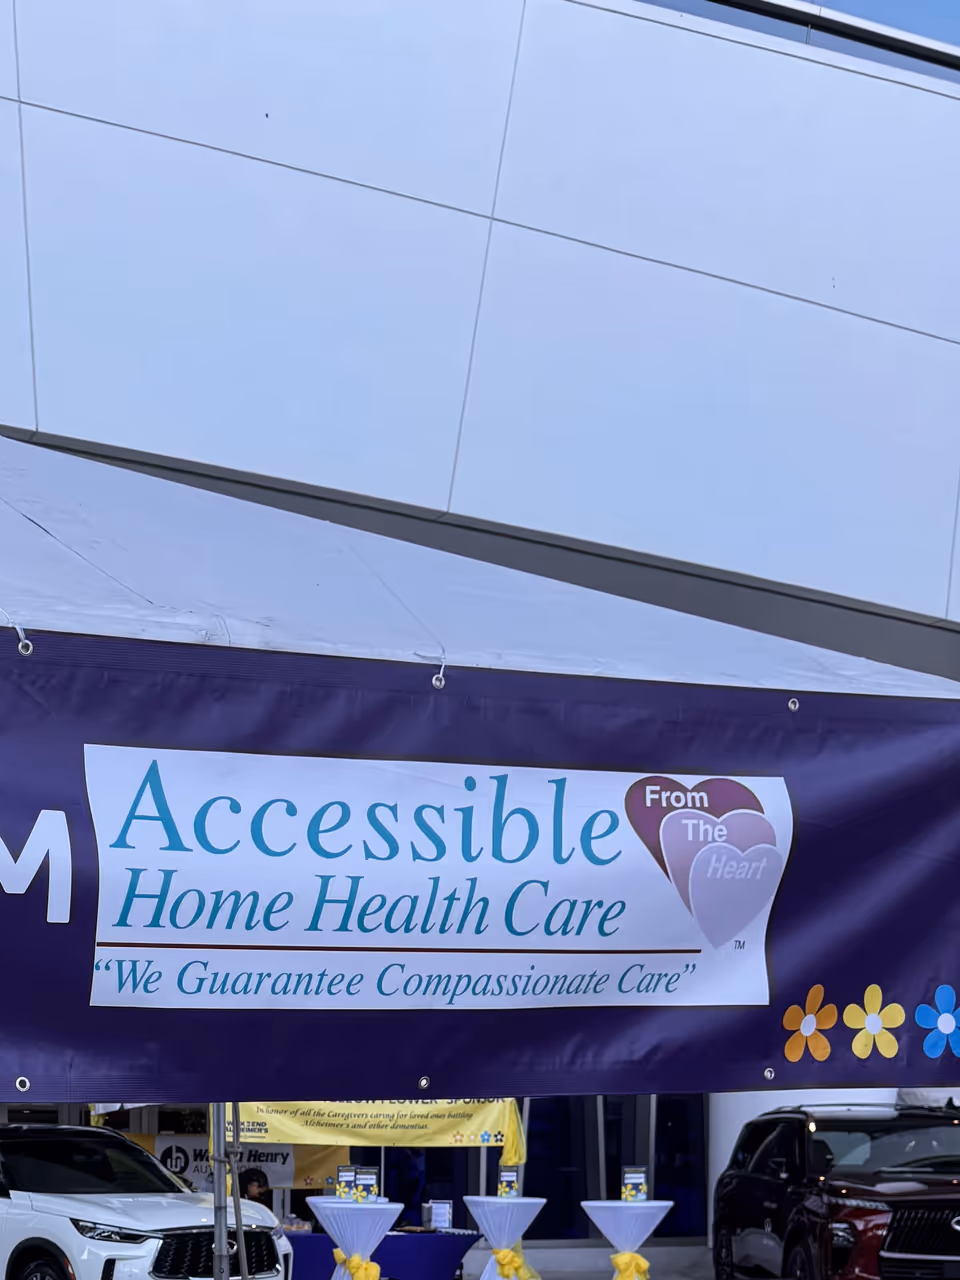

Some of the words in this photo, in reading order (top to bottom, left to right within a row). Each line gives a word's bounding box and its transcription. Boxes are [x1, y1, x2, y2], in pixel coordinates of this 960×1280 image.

[643, 785, 709, 811] From
[108, 759, 623, 867] Accessible
[681, 819, 728, 843] The
[706, 852, 768, 881] Heart
[111, 866, 294, 932] Home
[306, 874, 490, 938] Health
[502, 878, 628, 938] Care
[94, 959, 162, 995] "We
[177, 960, 364, 998] Guarantee
[376, 962, 610, 1007] Compassionate
[617, 962, 698, 995] Care"
[246, 1150, 290, 1165] Henry
